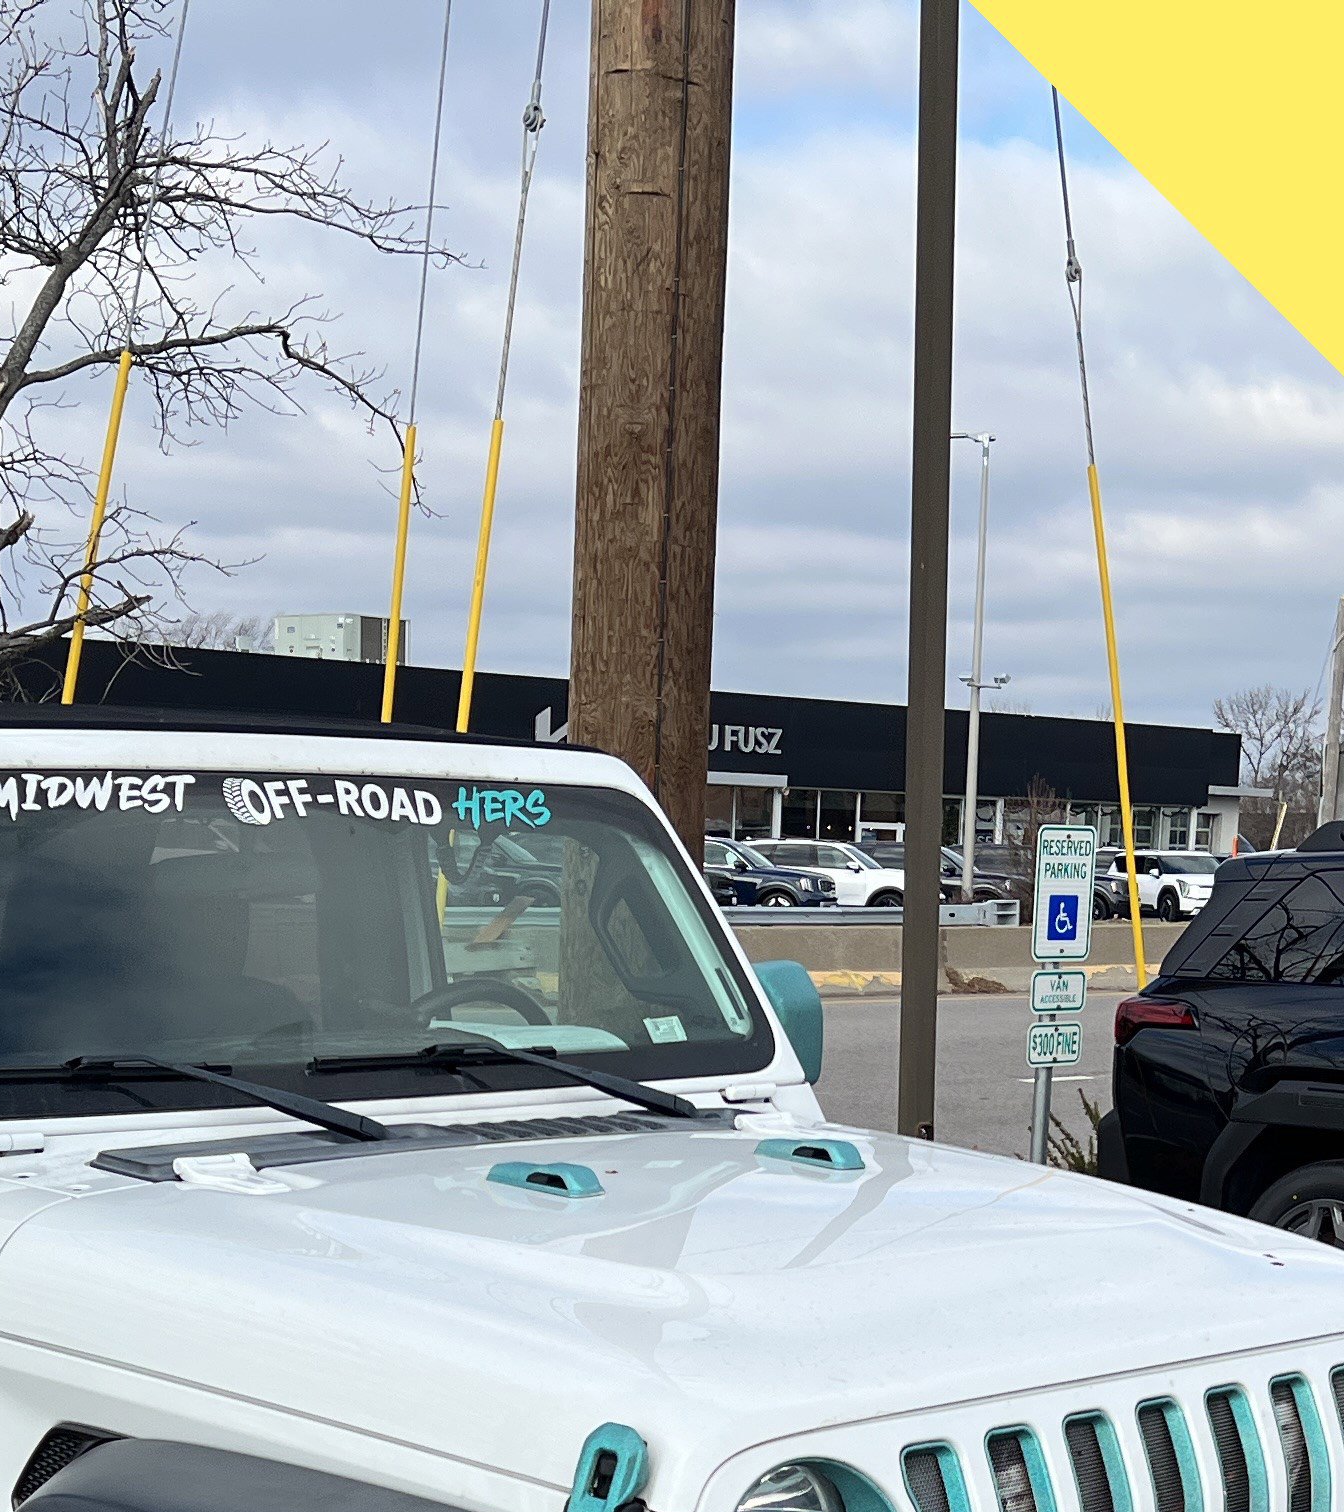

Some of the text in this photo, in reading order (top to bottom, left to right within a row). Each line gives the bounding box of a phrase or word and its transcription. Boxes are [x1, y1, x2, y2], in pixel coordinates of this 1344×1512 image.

[724, 725, 783, 755] FUSZ
[223, 777, 442, 825] OFF-ROAD
[453, 786, 551, 829] HERS
[1042, 839, 1092, 857] RESERVED
[1044, 862, 1087, 879] PARKING
[1050, 980, 1069, 992] VAN
[1040, 993, 1077, 1004] ACCESSIBLE
[1032, 1031, 1078, 1057] $300 FINE
